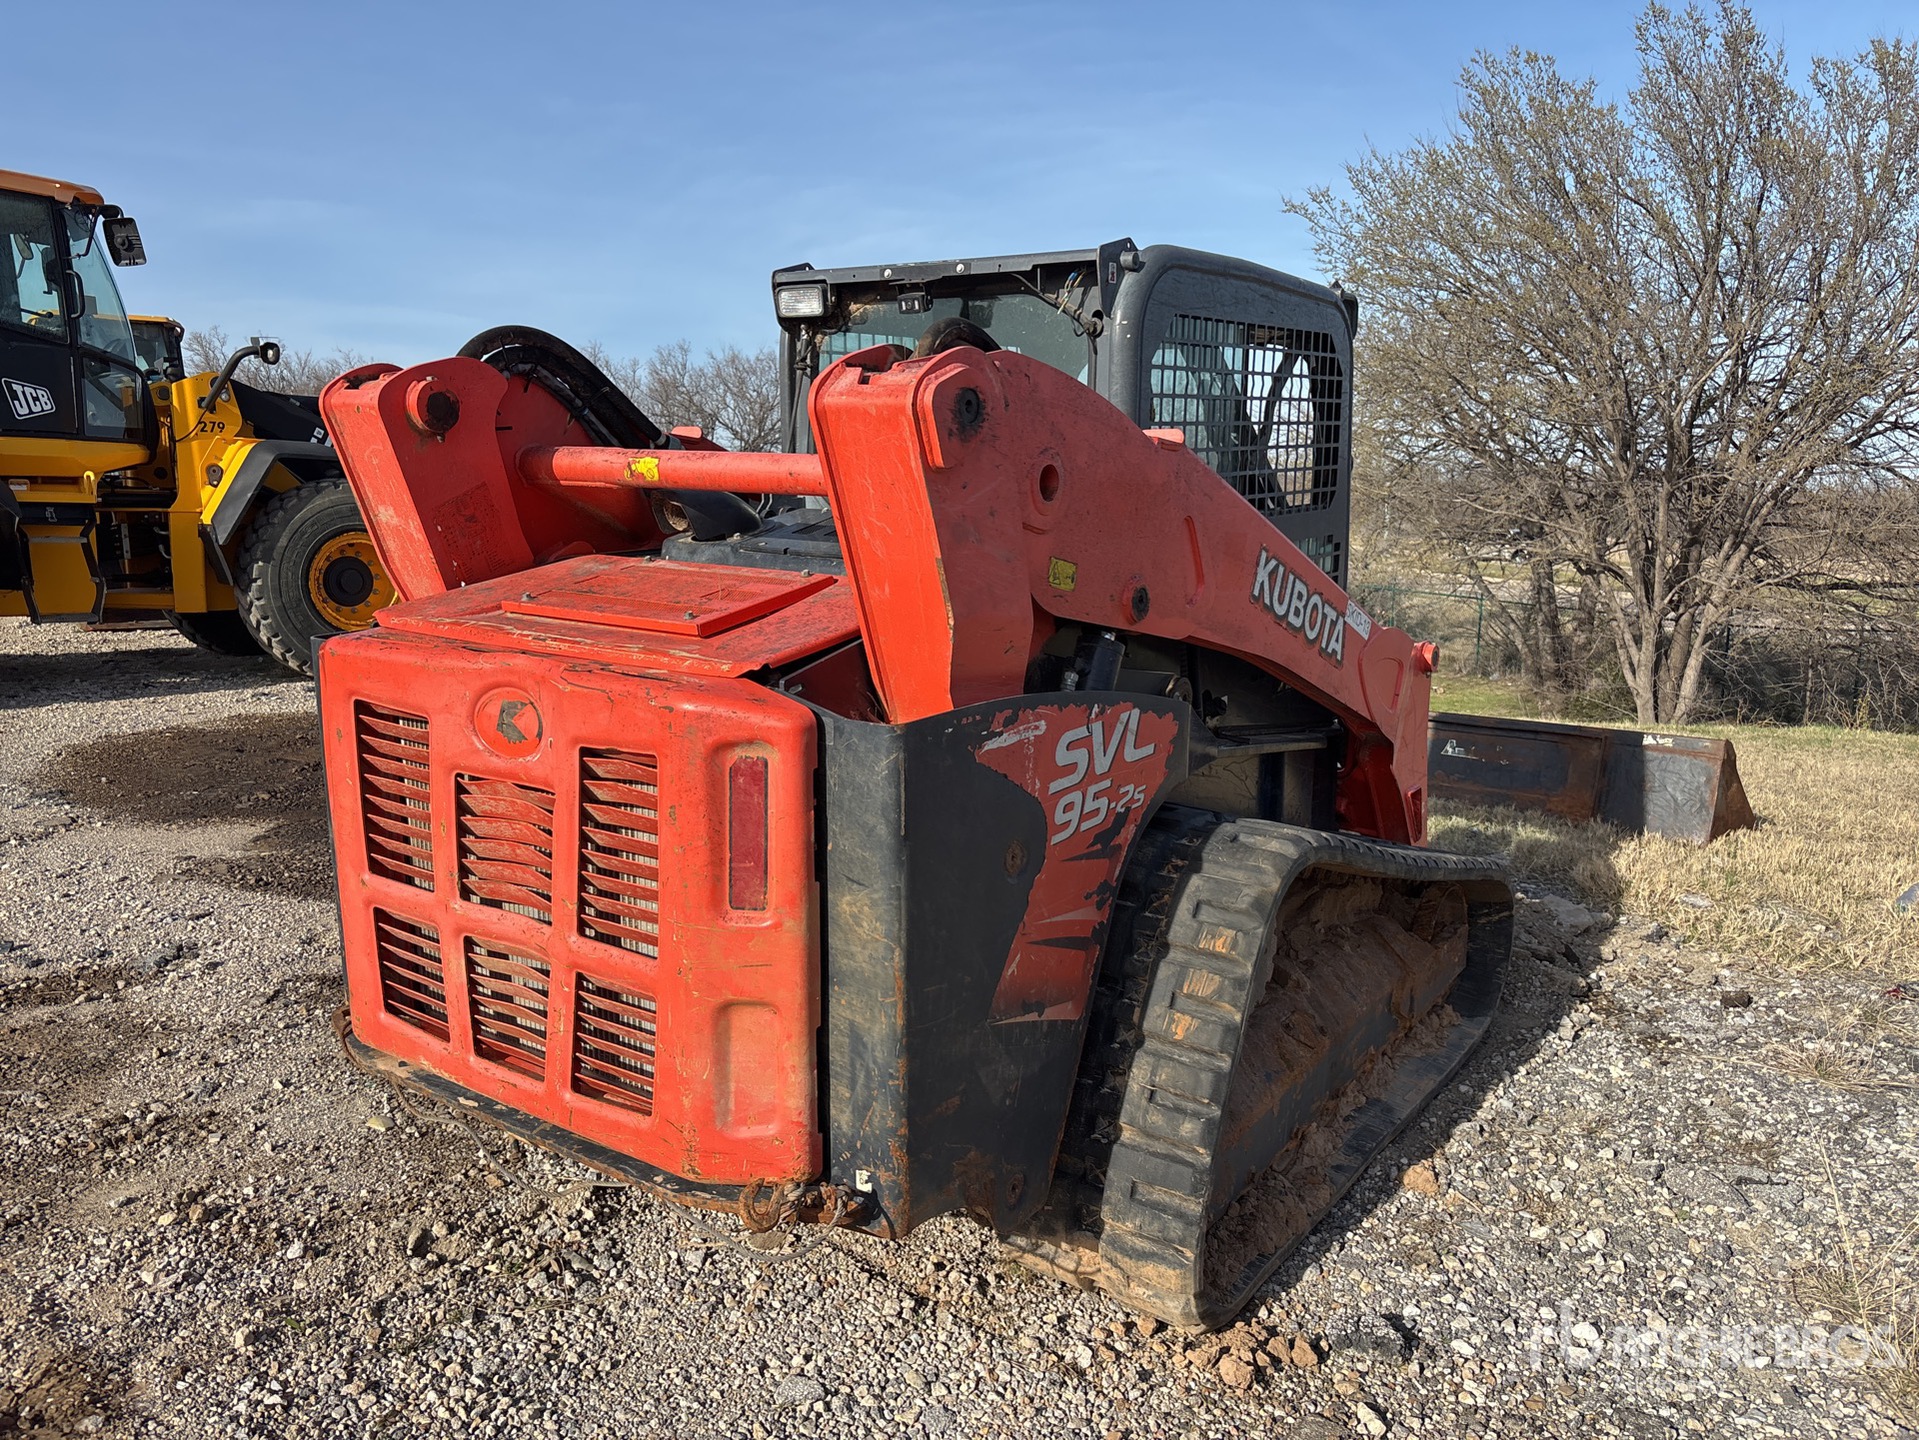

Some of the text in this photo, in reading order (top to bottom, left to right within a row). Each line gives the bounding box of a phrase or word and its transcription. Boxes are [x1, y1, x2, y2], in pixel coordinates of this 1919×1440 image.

[11, 383, 52, 415] JCB
[200, 421, 225, 433] 279
[1252, 549, 1344, 662] KUBOTA
[1048, 708, 1155, 796] SVL
